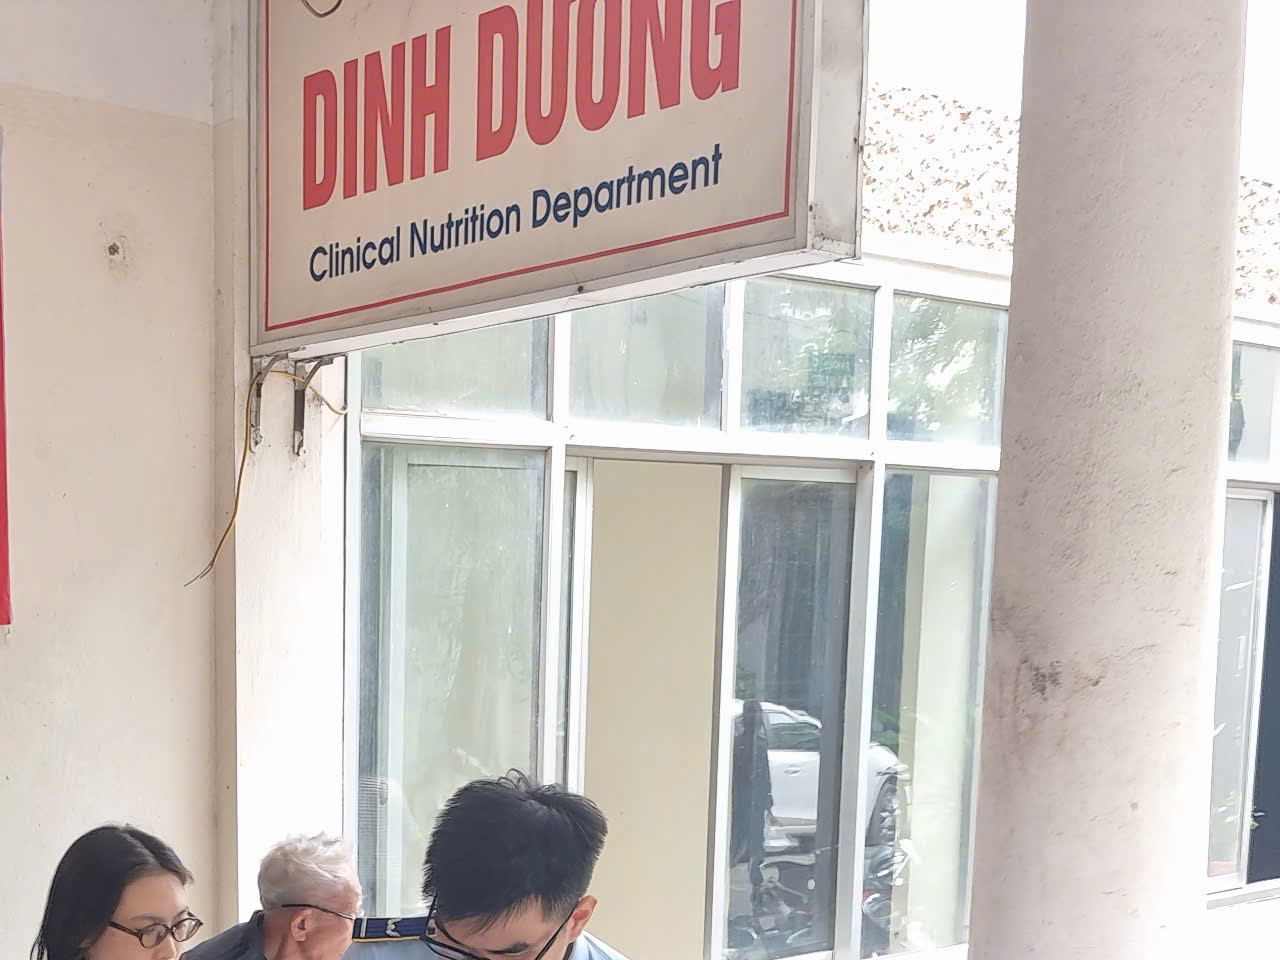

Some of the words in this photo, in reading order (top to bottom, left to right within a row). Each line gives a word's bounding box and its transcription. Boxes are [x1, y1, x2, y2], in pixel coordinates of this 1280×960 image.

[303, 25, 451, 210] DINH
[310, 226, 401, 282] Clinical
[409, 203, 521, 257] Nutrition
[531, 143, 723, 228] Department
